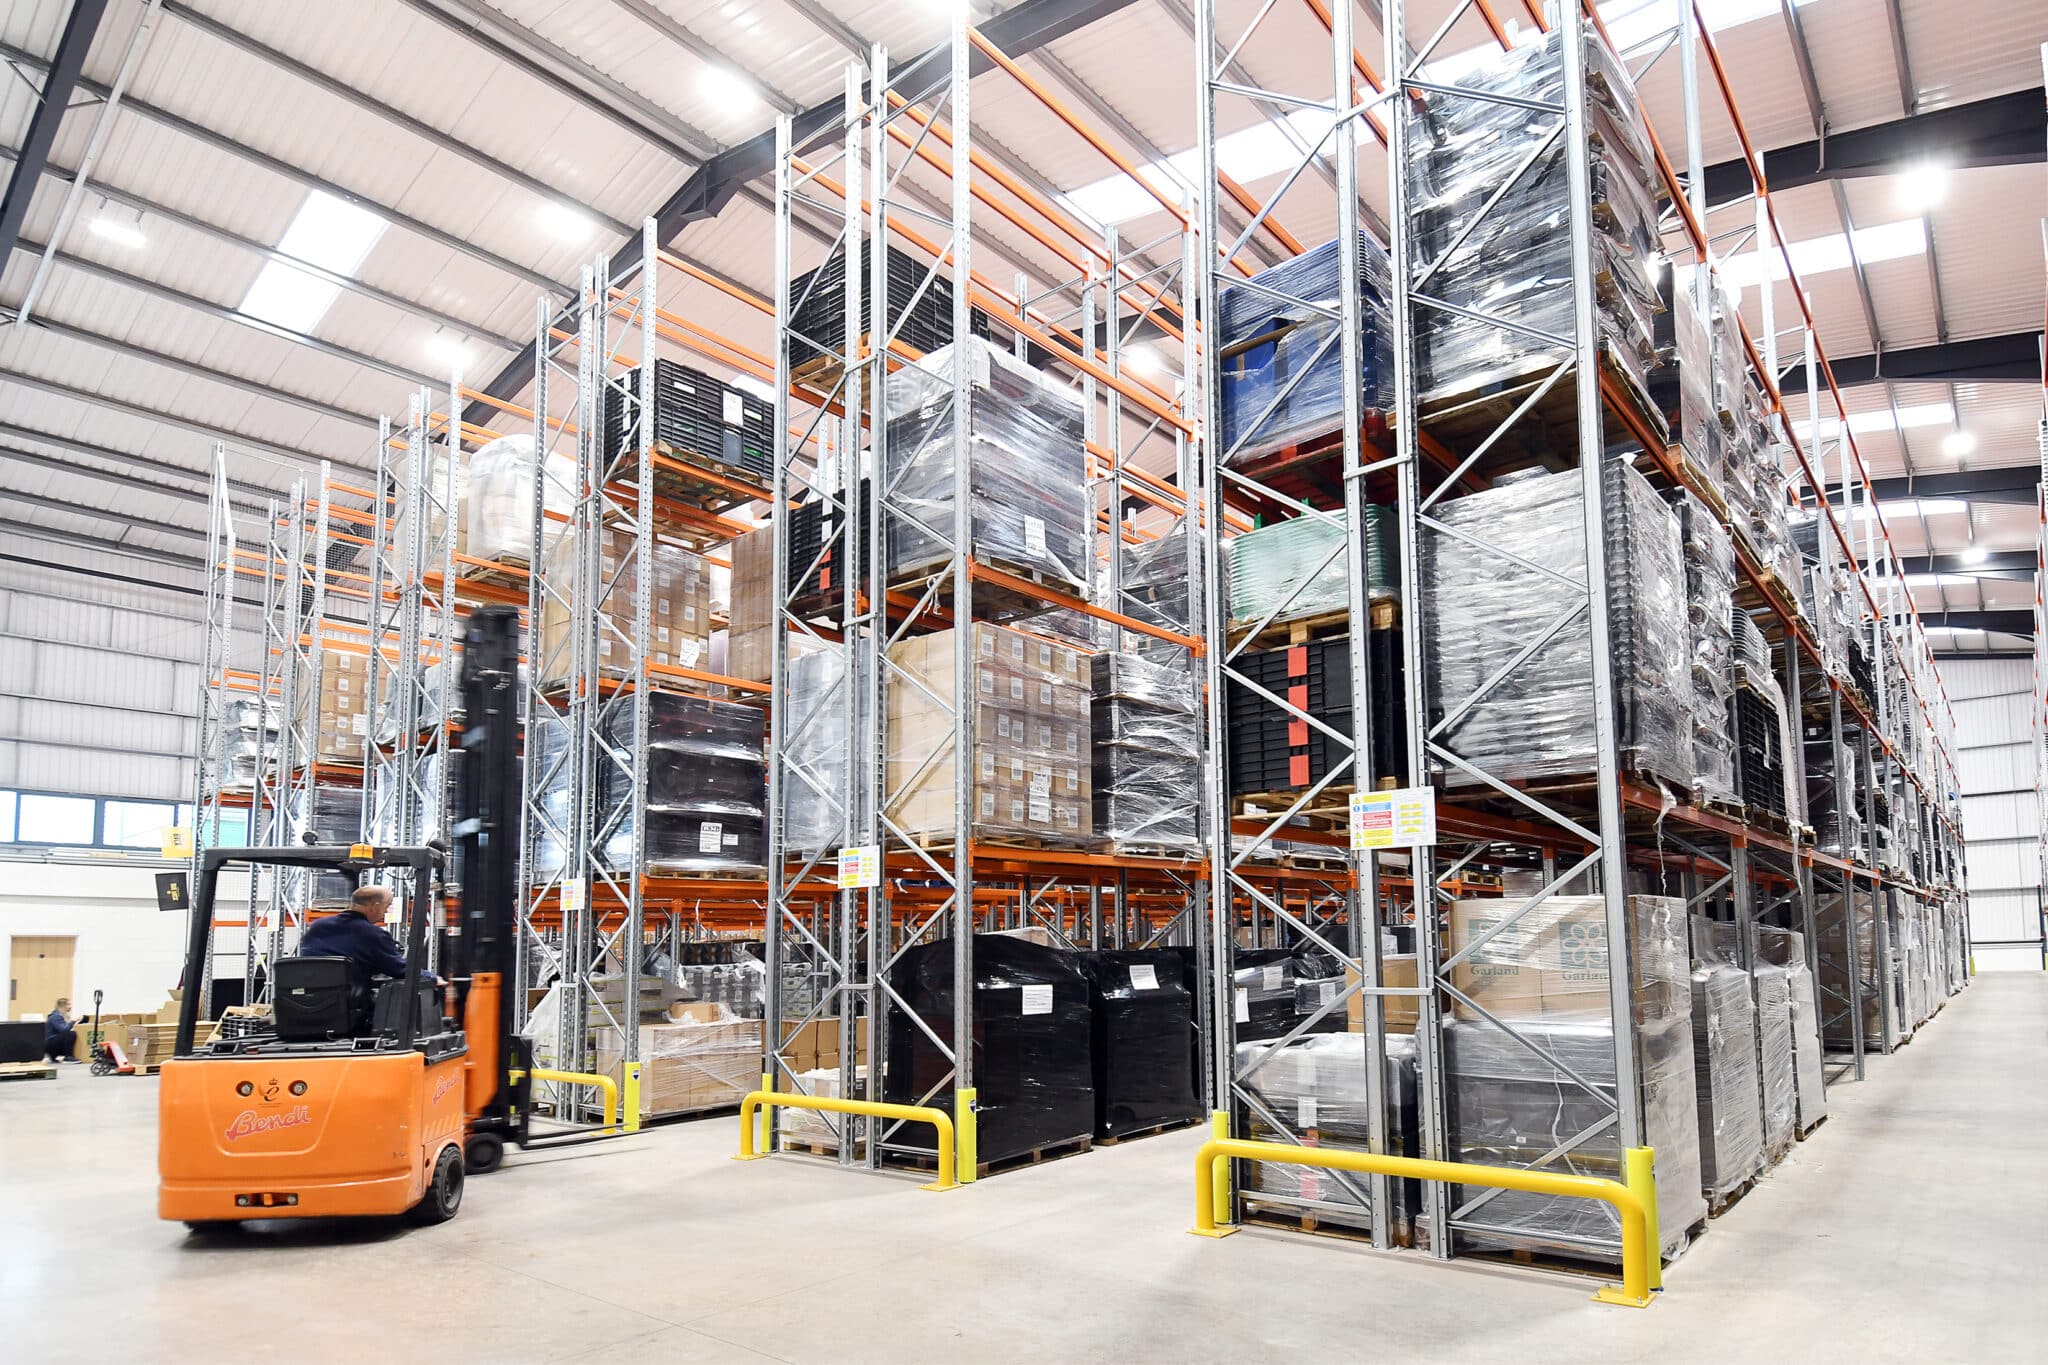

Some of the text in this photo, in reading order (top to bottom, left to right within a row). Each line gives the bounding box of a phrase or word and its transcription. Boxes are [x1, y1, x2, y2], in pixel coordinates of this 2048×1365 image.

[1470, 964, 1519, 976] Garland
[1562, 970, 1609, 981] Garlan
[225, 1105, 312, 1141] Bendi
